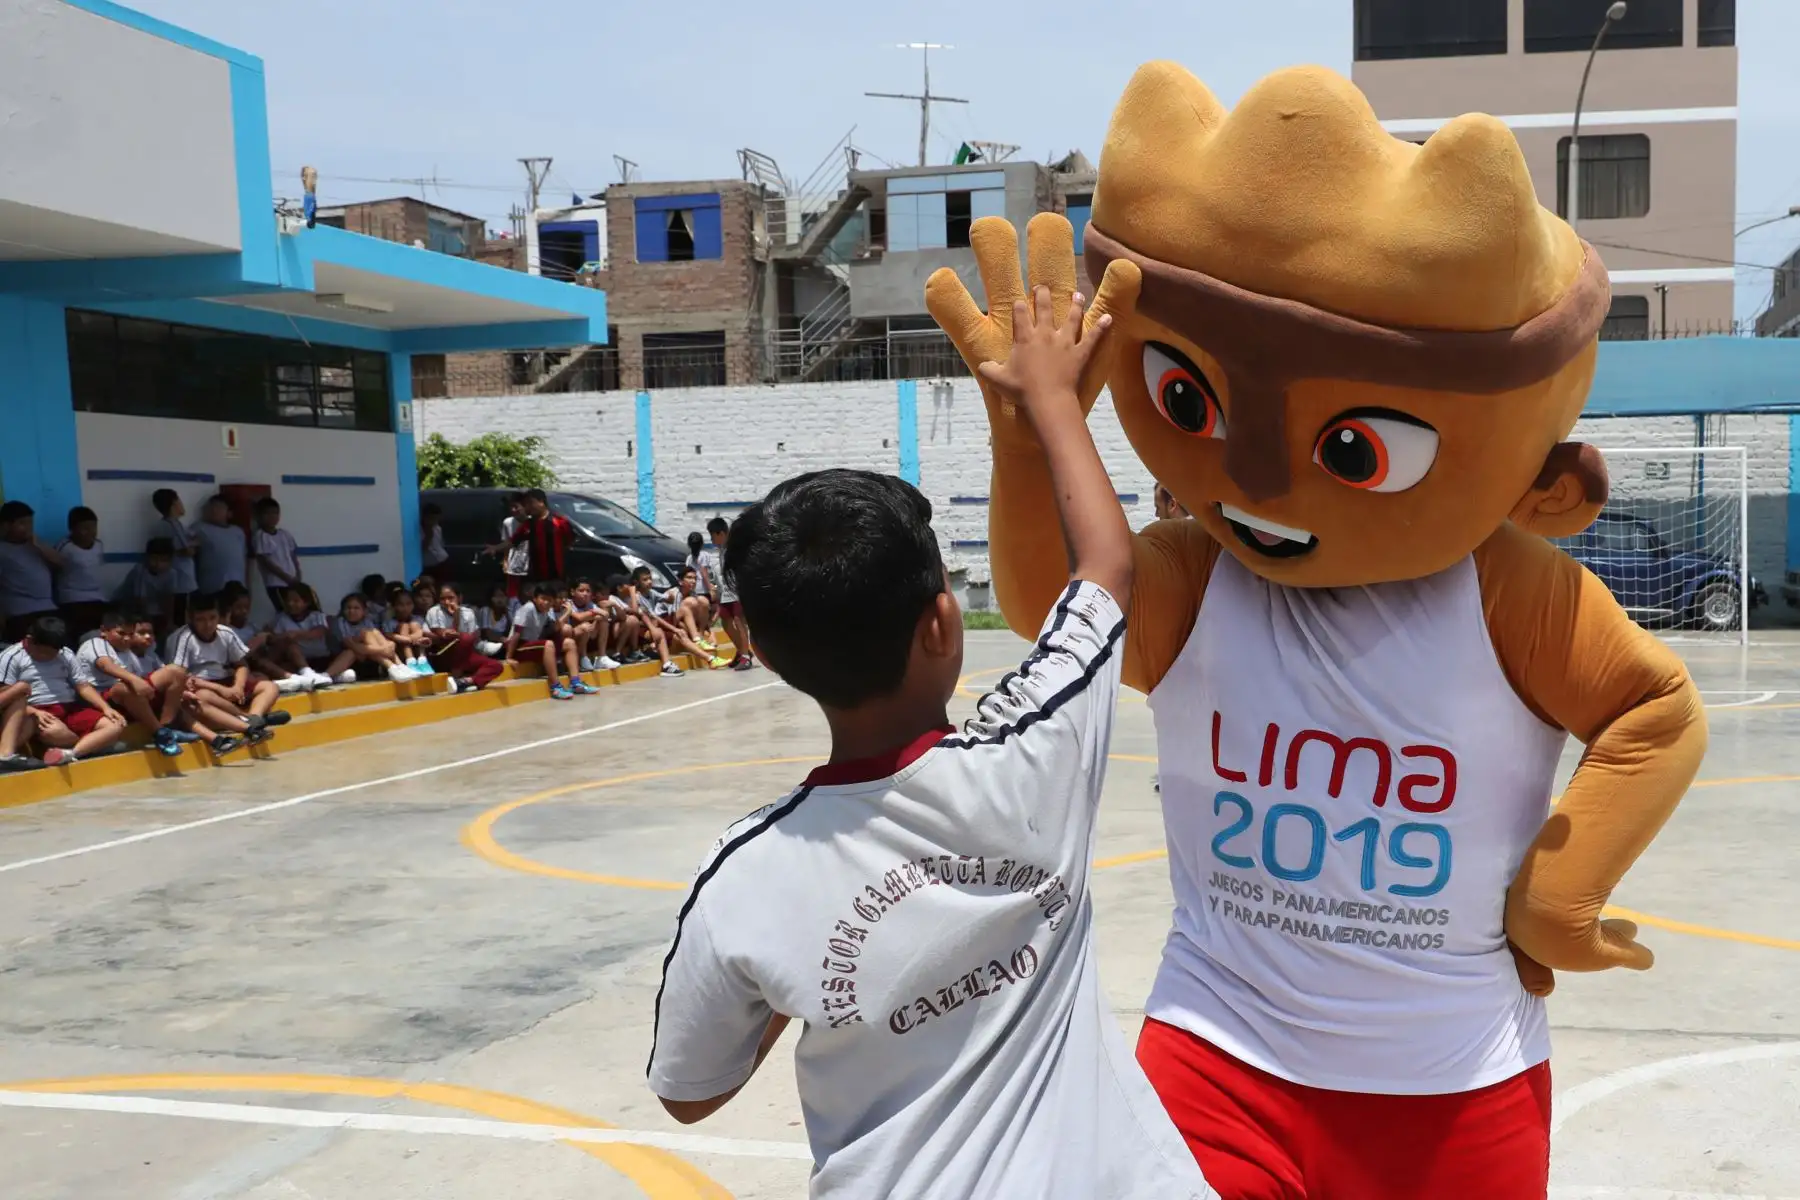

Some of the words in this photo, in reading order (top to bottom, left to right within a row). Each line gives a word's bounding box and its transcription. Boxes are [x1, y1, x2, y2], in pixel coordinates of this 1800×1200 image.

[1211, 791, 1453, 897] 2019
[821, 918, 869, 1029] NESTOR
[852, 854, 987, 923] GAMBETTA
[1208, 871, 1265, 902] JUEGOS
[1272, 889, 1450, 926] PANAMERICANOS
[1208, 894, 1220, 913] Y
[1223, 900, 1446, 950] PARAPANAMERICANOS
[889, 943, 1039, 1035] CALLAO
